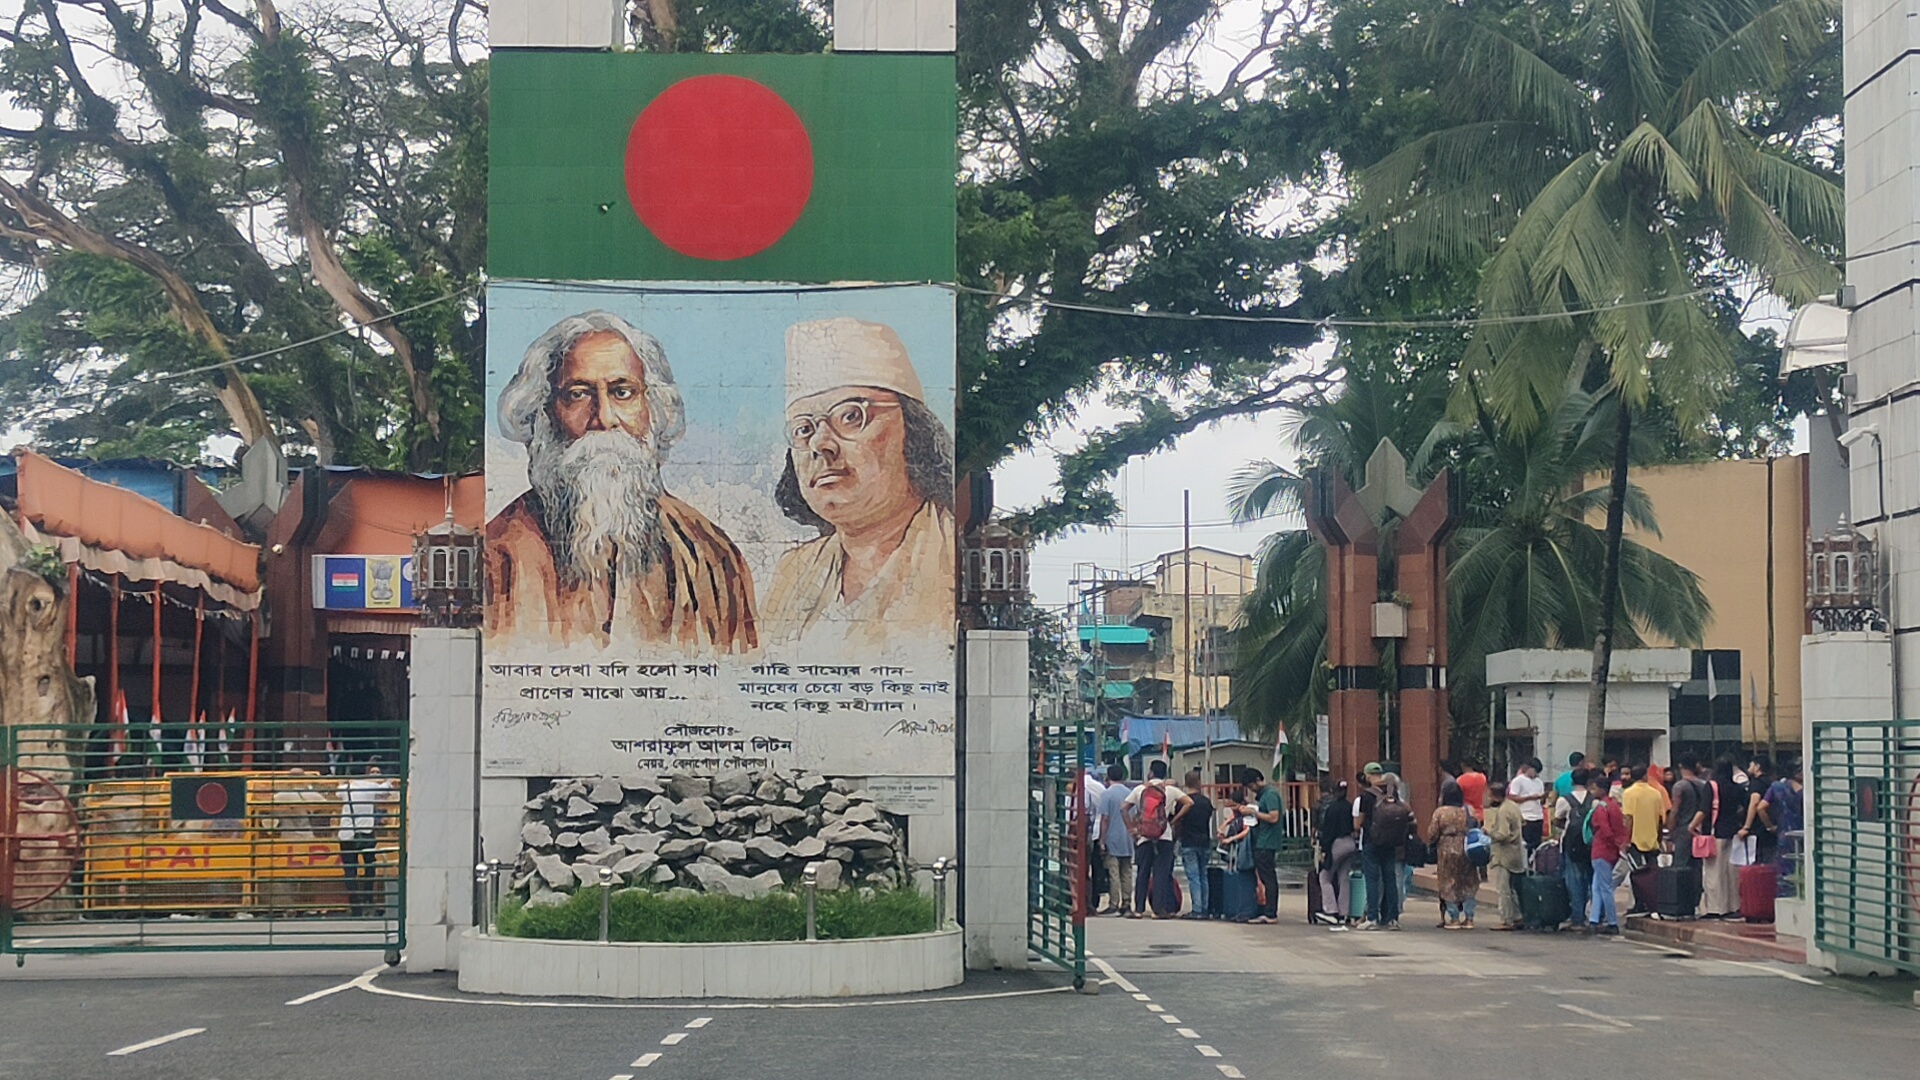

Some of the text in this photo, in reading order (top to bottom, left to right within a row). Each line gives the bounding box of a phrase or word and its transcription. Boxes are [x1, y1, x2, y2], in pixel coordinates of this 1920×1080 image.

[488, 661, 718, 677] আবার দেখা যদি হলো সখা
[751, 663, 790, 675] গাহি
[797, 665, 861, 676] সাম্যের
[520, 687, 573, 699] প্রাণের
[579, 687, 624, 699] মাঝে
[805, 683, 842, 693] চেয়ে
[848, 683, 874, 695] বড়
[881, 680, 914, 696] কিছু
[919, 681, 950, 694] নাই
[750, 701, 788, 712] নহে
[793, 698, 831, 714] কিছু
[837, 698, 904, 712] মহীয়ান
[611, 736, 792, 756] আশরাফুল আলম লিটন
[125, 846, 210, 868] LPAI
